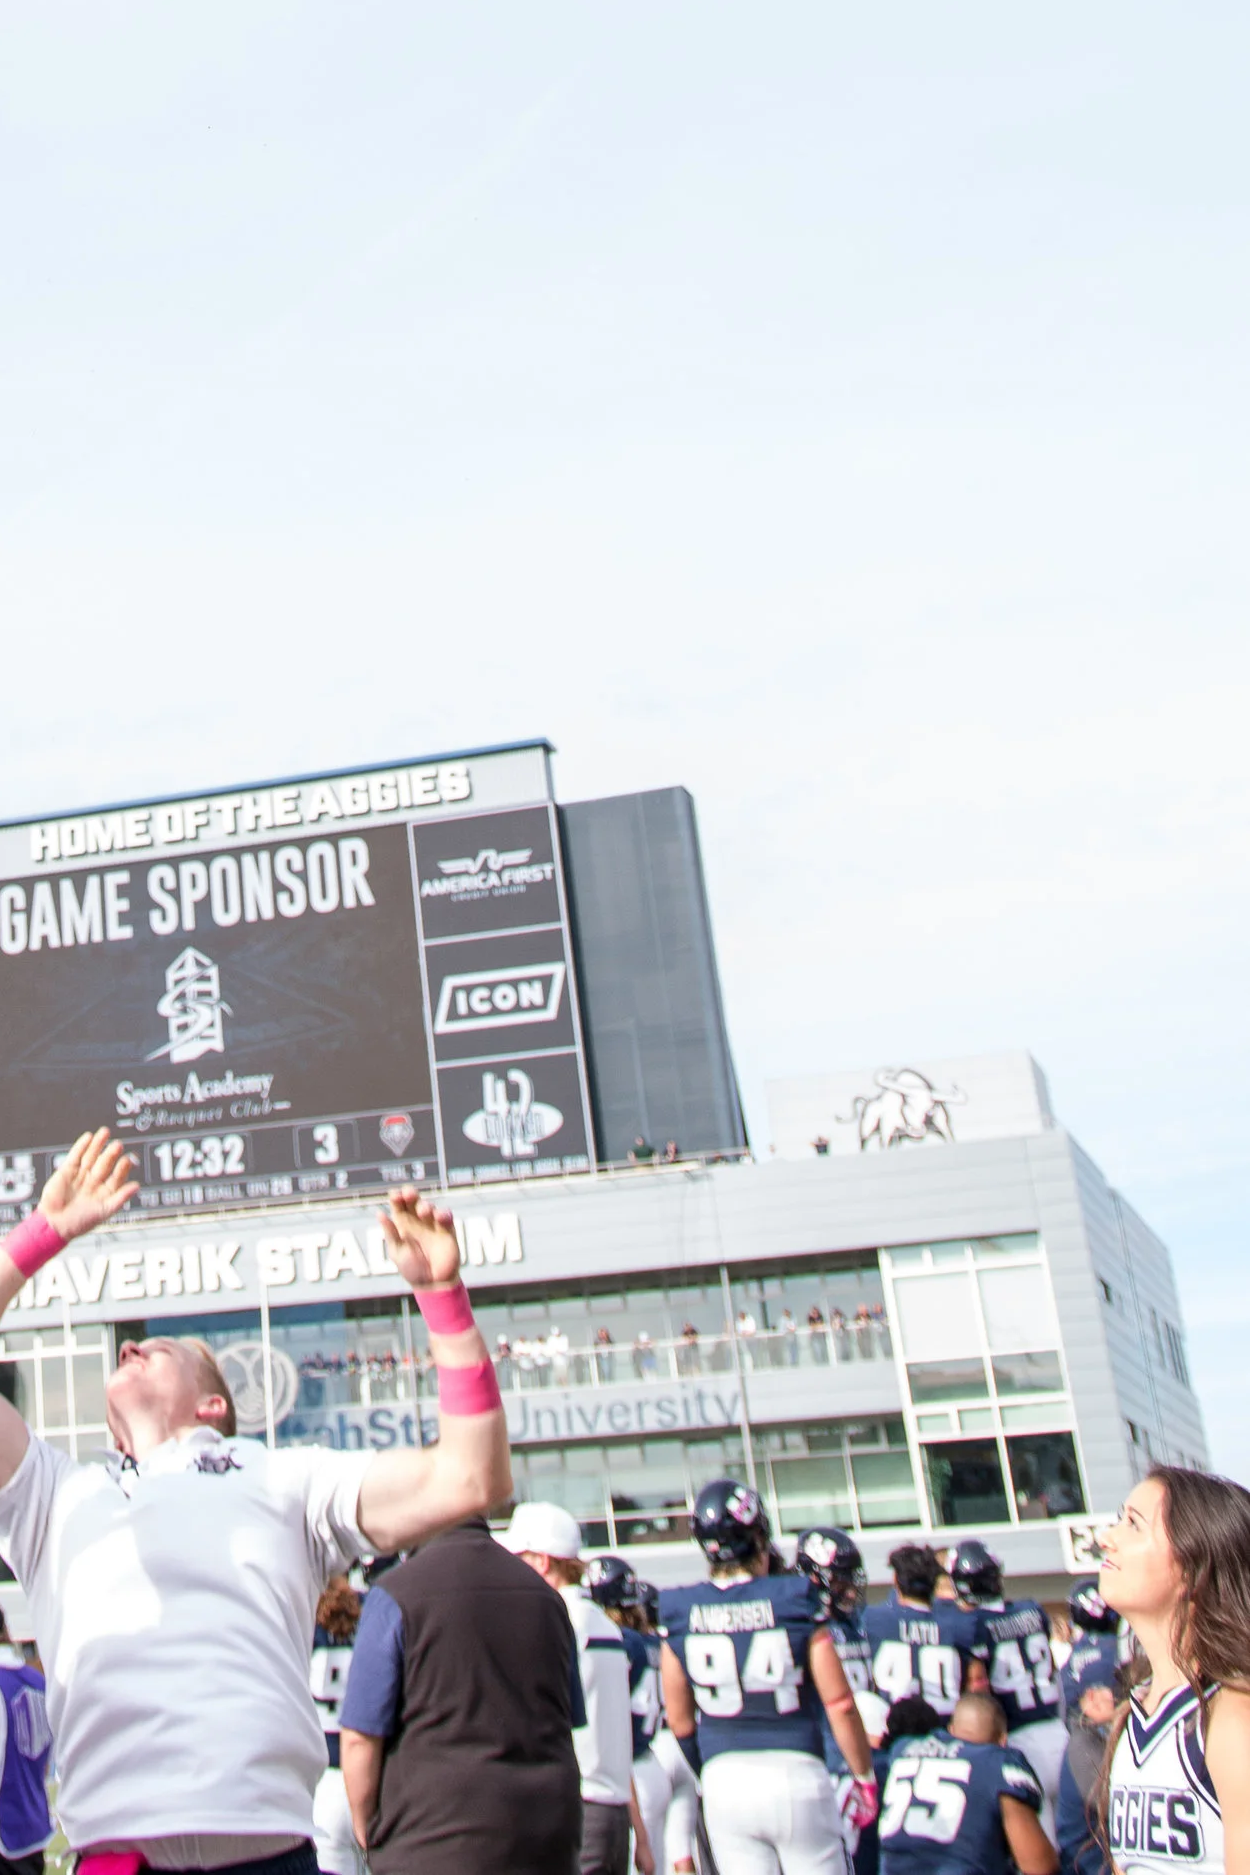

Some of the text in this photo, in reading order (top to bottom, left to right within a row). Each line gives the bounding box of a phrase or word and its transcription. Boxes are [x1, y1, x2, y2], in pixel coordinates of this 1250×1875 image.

[30, 762, 471, 864] HOME OF THE AGGIES
[147, 836, 376, 937] SPONSOR
[420, 862, 555, 899] AMERICA FIRST
[455, 979, 545, 1016] ICON
[116, 1069, 275, 1115] Sports Academy
[229, 1098, 273, 1119] Club
[154, 1133, 245, 1182] 12:32
[313, 1124, 341, 1165] 3
[335, 1169, 349, 1190] 2
[257, 1211, 523, 1286] STADM
[689, 1598, 775, 1634] ANDERSEN
[899, 1619, 940, 1646] LATU
[684, 1627, 803, 1717] 94
[872, 1639, 962, 1715] 40
[878, 1756, 972, 1845] 55
[1110, 1787, 1202, 1860] GGIES
